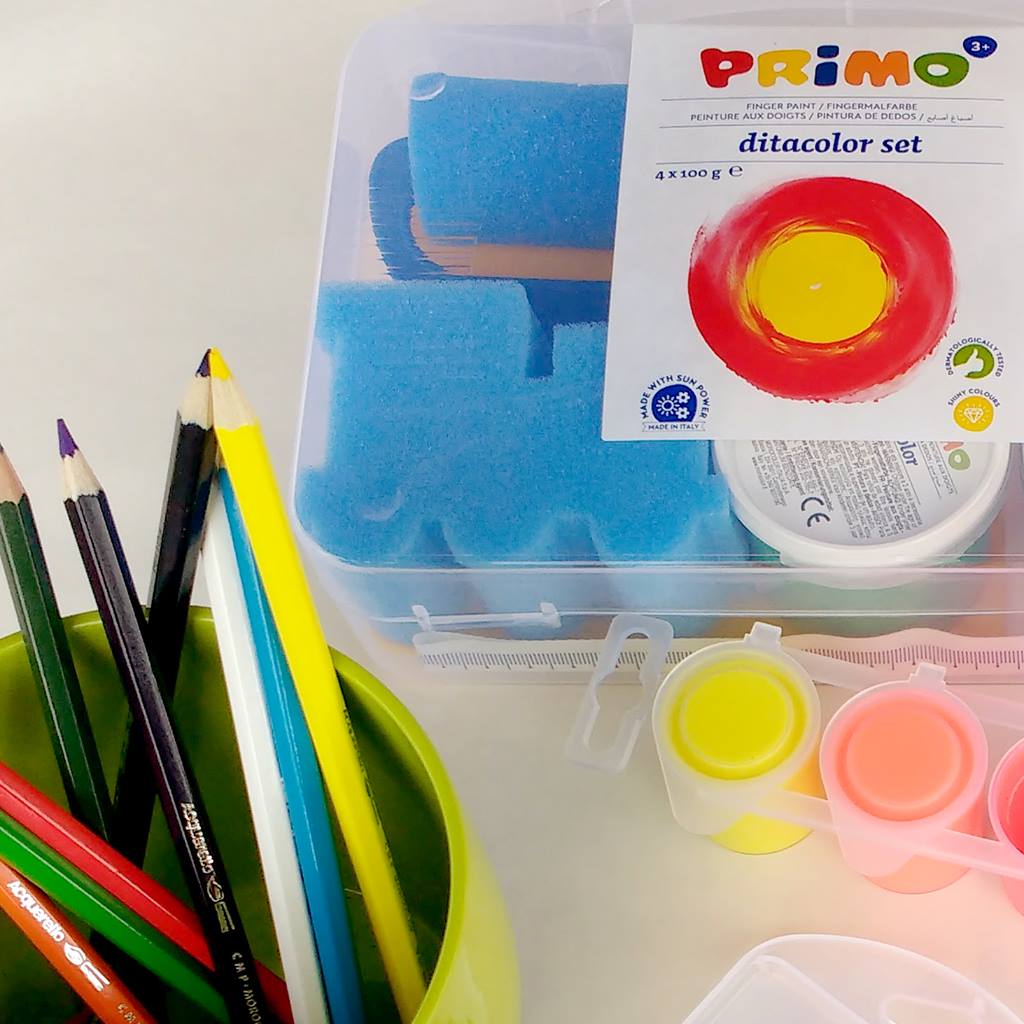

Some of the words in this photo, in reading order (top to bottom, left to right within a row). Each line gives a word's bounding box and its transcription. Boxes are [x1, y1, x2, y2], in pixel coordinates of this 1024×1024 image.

[971, 41, 990, 52] 3+
[690, 113, 740, 121] PEINTURE
[742, 112, 765, 120] AUX
[767, 112, 807, 120] DOIGTS
[881, 113, 917, 121] DEDOS
[746, 102, 784, 110] FINGER
[786, 102, 816, 110] PAINT
[826, 102, 918, 111] FINGERMALFARBE
[739, 132, 874, 153] ditacolor
[881, 136, 923, 153] set
[655, 169, 665, 180] 4
[668, 171, 678, 179] x
[680, 169, 707, 178] 100
[711, 168, 722, 180] g
[945, 337, 998, 376] DERMATOLOGICALLY
[995, 351, 1004, 377] TESTED
[640, 392, 651, 419] MADE
[648, 375, 674, 390] WITH
[676, 374, 698, 386] SUN
[696, 385, 710, 419] POWER
[948, 389, 966, 406] SHINY
[968, 388, 1000, 408] COLOURS
[181, 802, 214, 874] Acquerello
[7, 880, 66, 943] Acquerello
